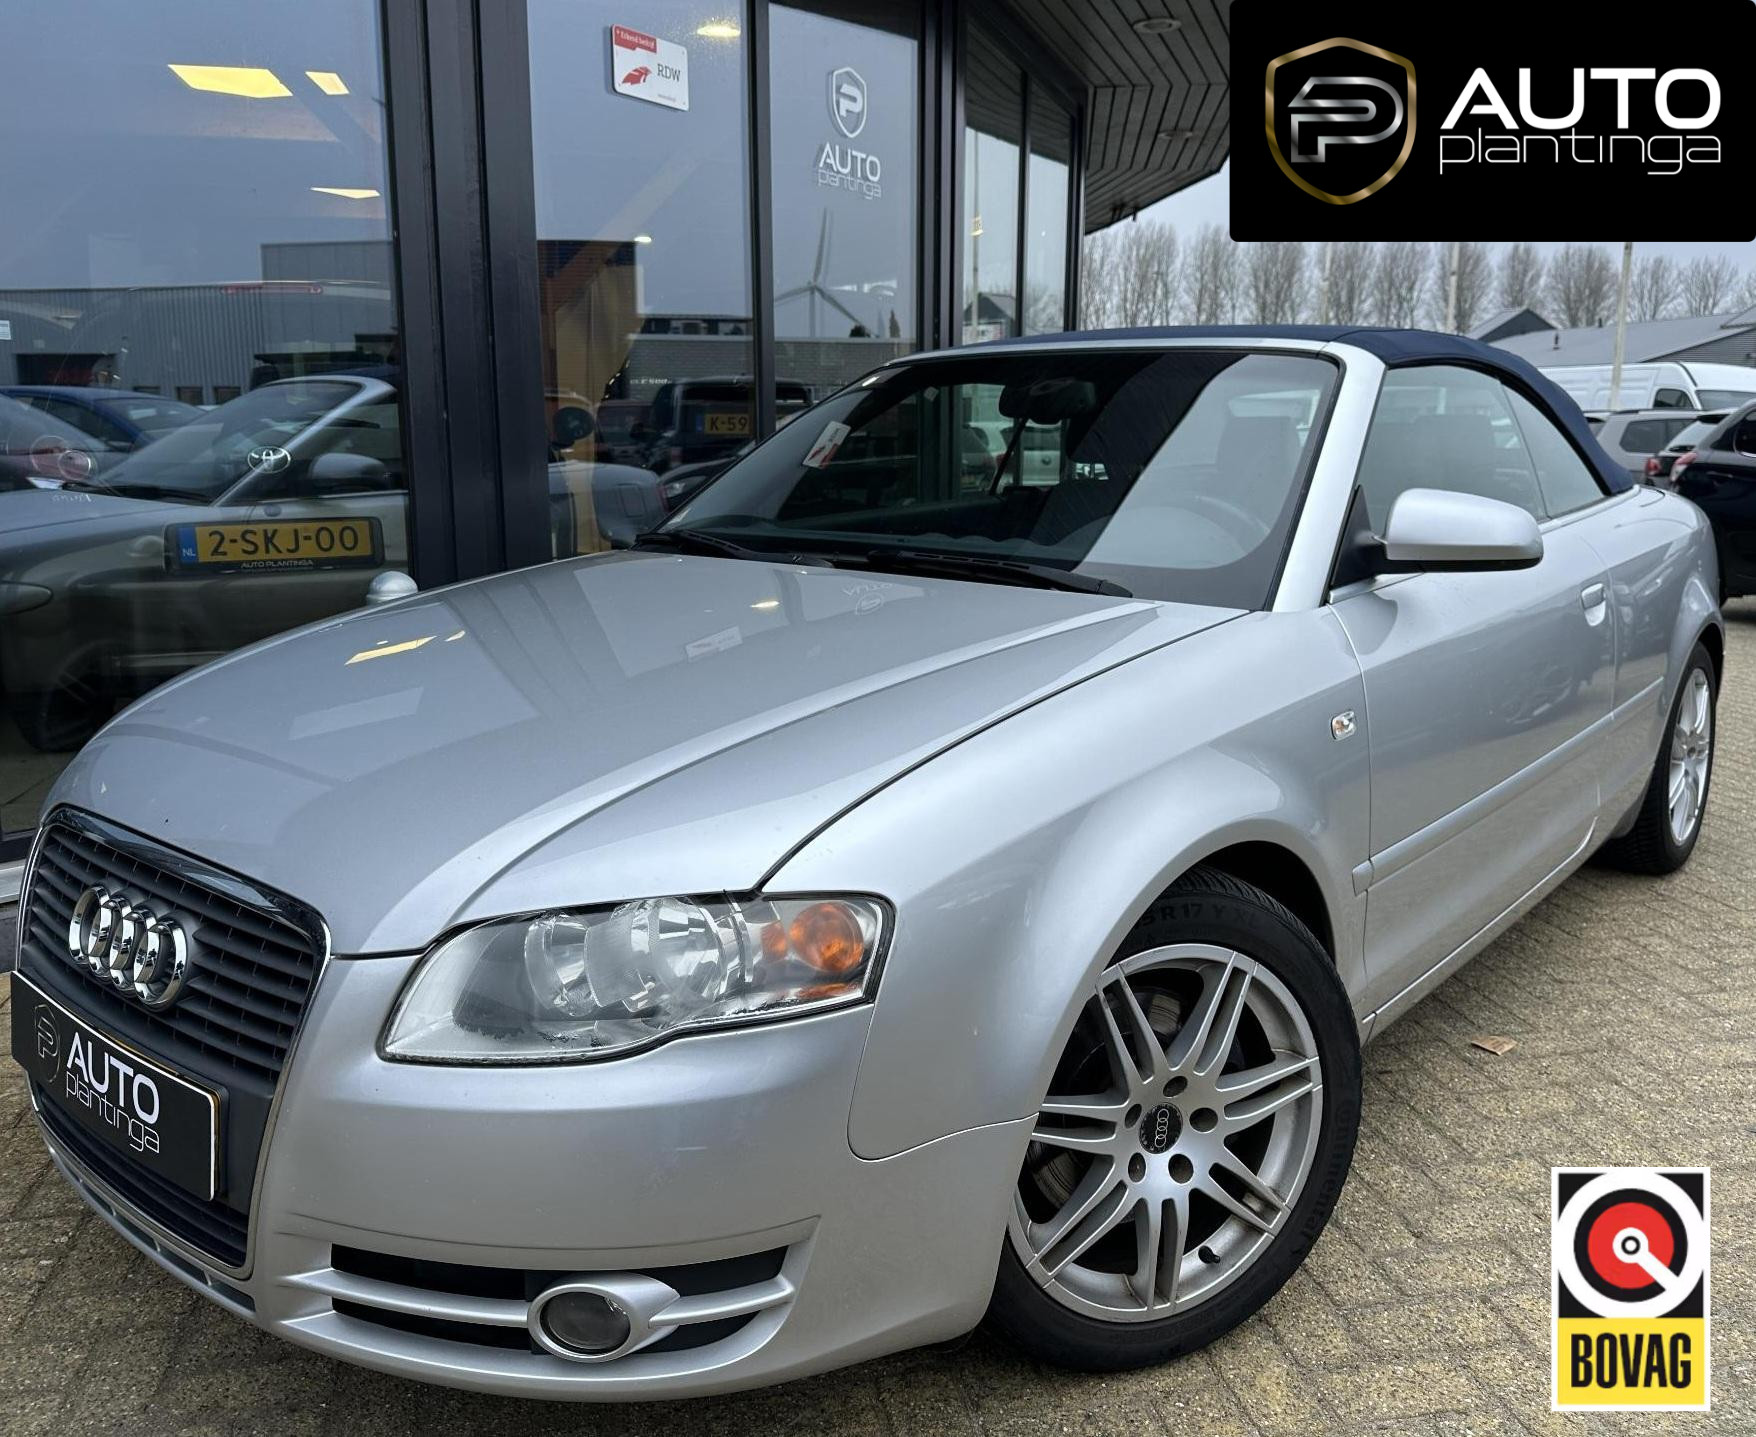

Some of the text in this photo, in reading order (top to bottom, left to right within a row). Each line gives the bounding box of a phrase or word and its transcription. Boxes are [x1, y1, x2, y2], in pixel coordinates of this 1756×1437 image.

[657, 63, 681, 82] RDW
[819, 142, 881, 182] AUTO
[818, 169, 881, 200] plantinga
[709, 416, 748, 432] K-59
[182, 548, 196, 557] NL
[209, 526, 359, 557] 2-SKJ-00
[241, 559, 314, 569] AUTO PLANTINGA
[66, 1032, 160, 1125] AUTO
[66, 1071, 160, 1154] plantinga
